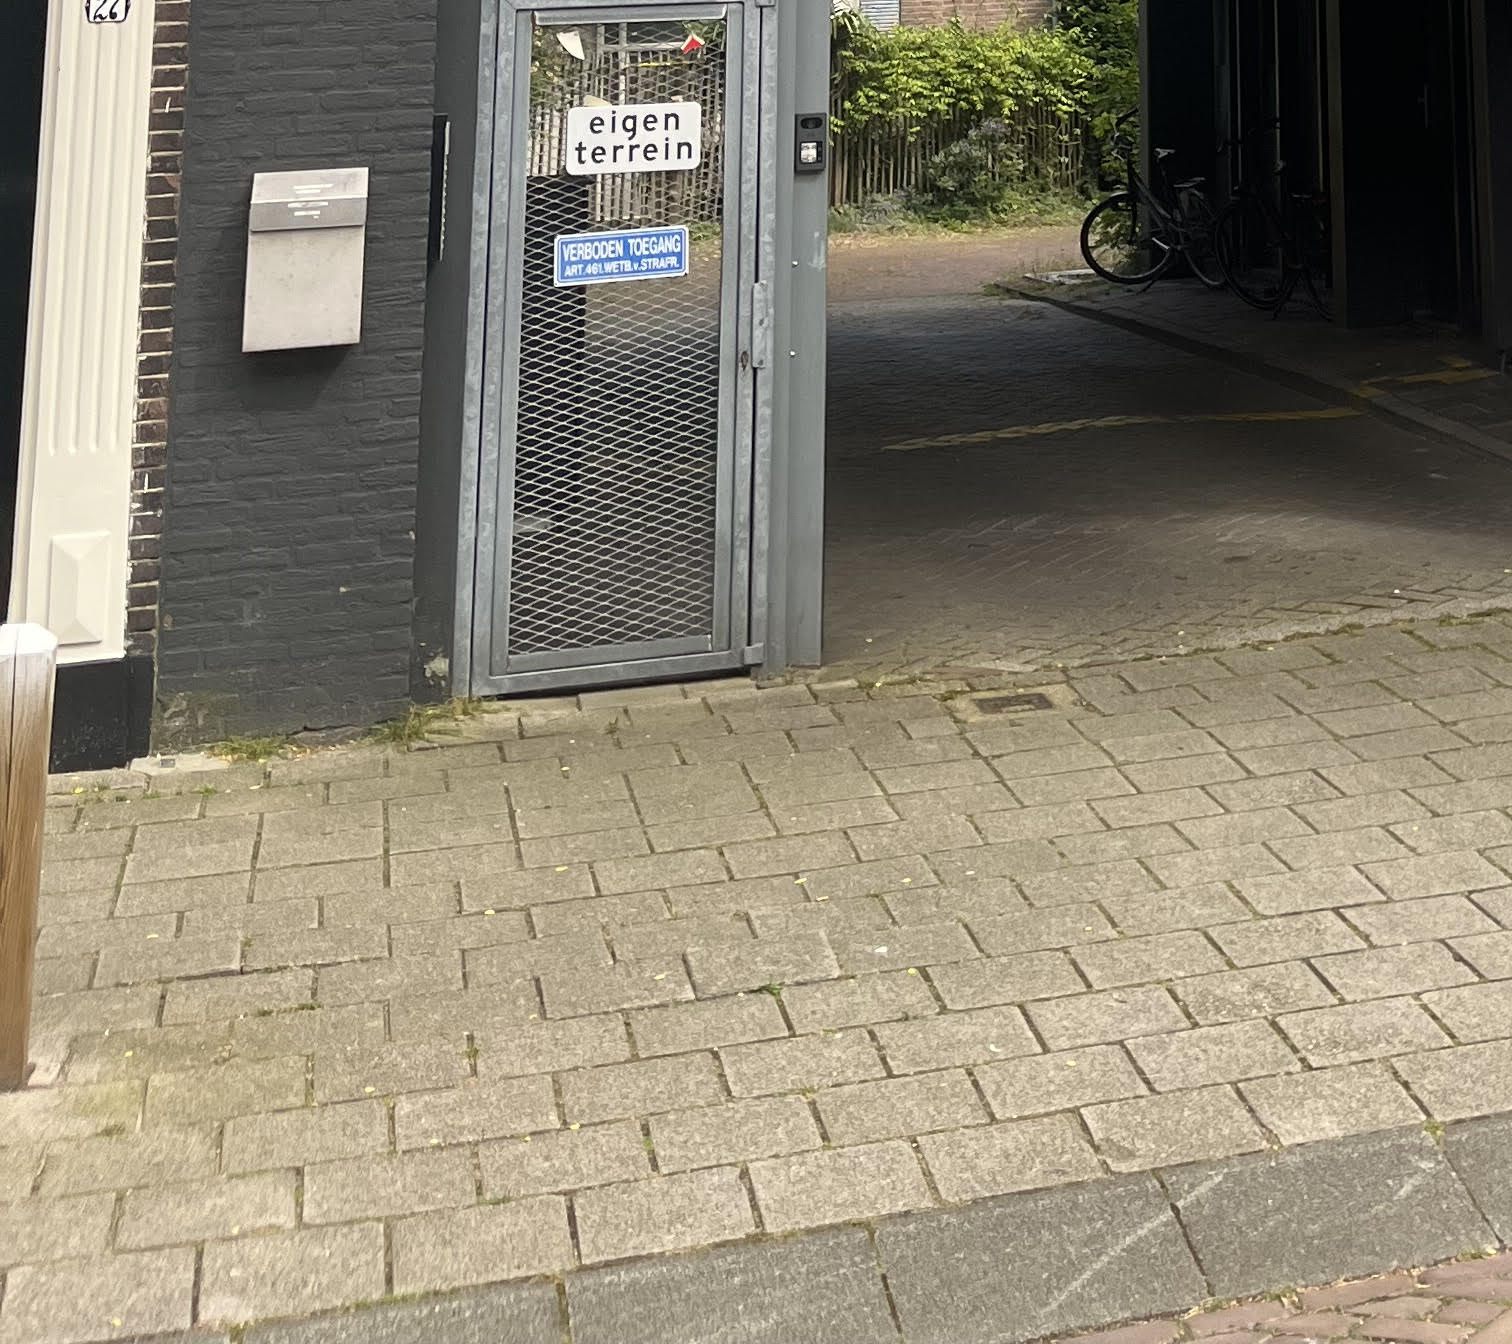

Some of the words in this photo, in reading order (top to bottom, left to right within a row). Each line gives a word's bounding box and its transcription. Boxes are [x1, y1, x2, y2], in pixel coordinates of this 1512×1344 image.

[589, 110, 680, 140] eigen
[574, 137, 693, 165] terrein
[562, 239, 624, 262] VERBODEN
[627, 234, 681, 257] TOEGANG
